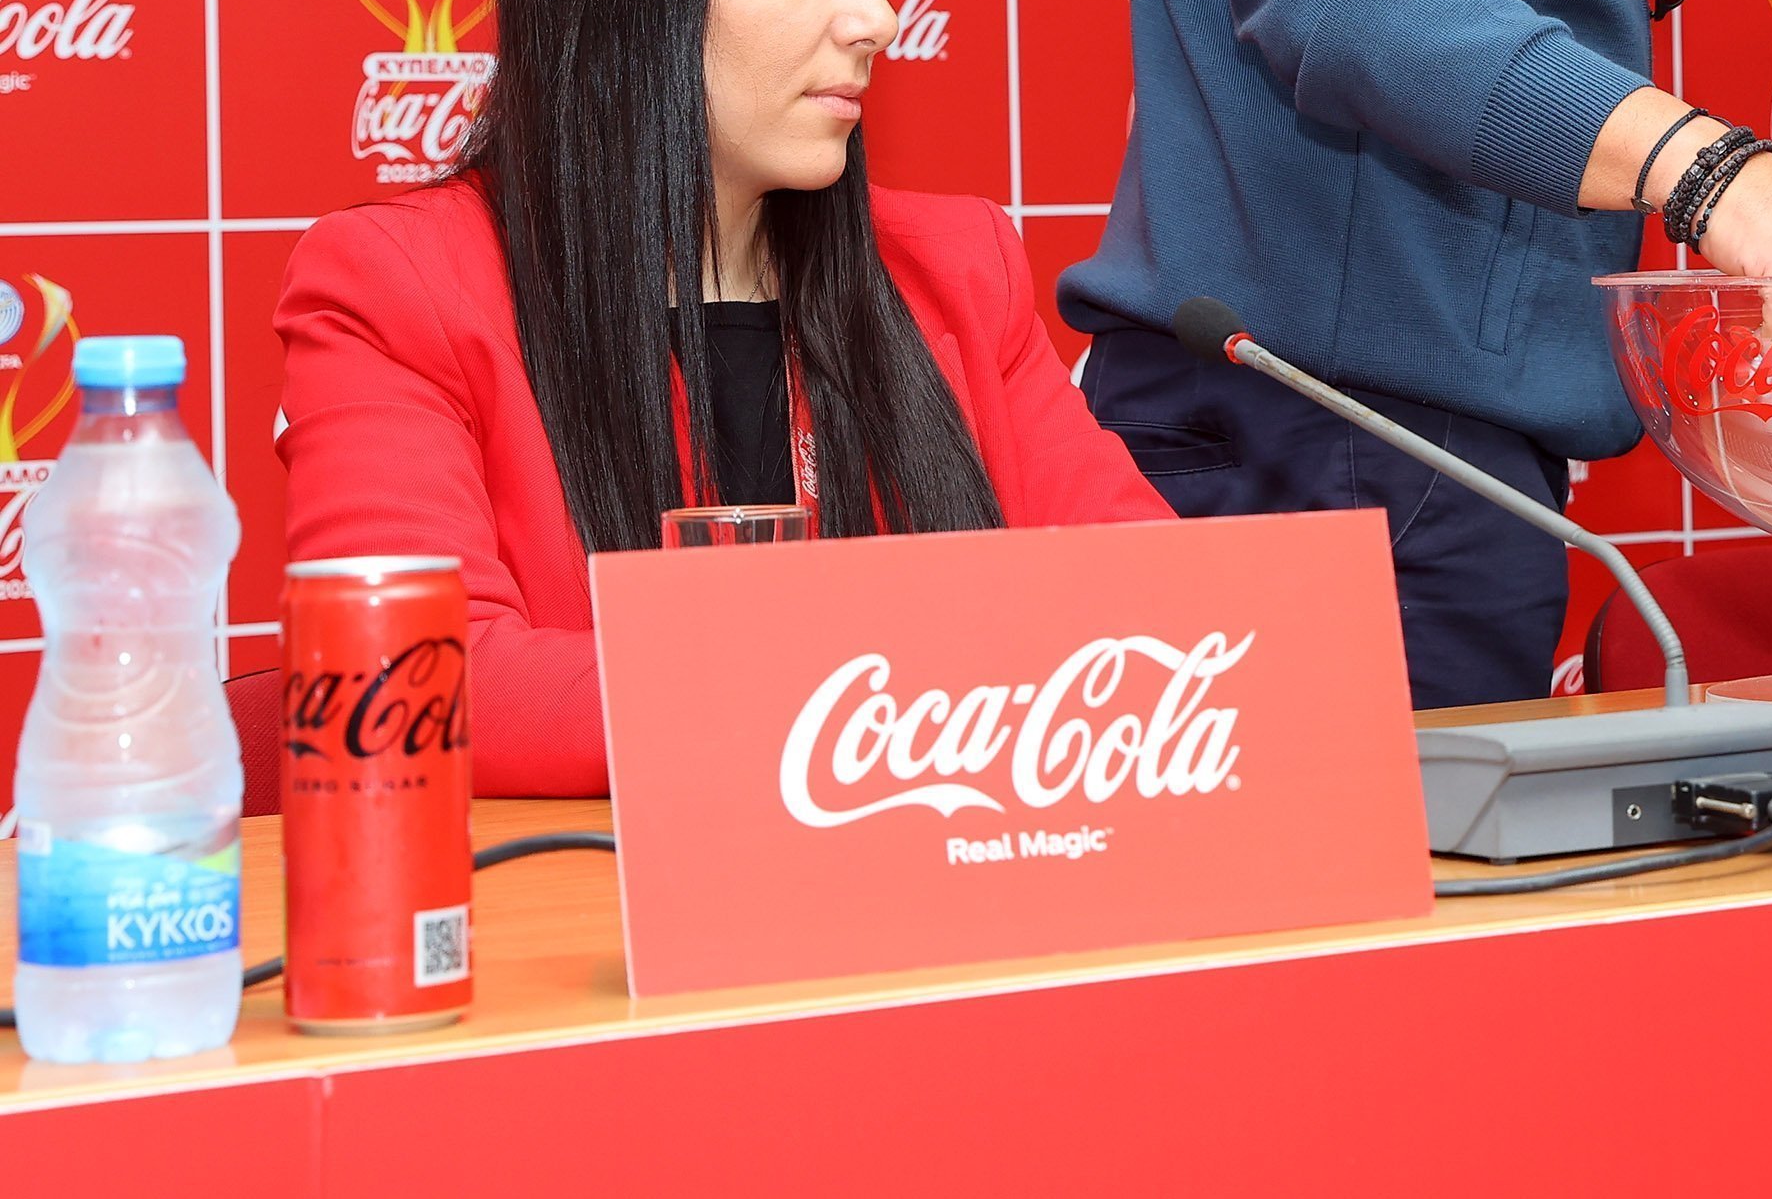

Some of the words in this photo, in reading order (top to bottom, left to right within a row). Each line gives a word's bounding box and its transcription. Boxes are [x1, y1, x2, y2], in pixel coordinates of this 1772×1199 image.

[376, 163, 460, 183] 2023-
[779, 630, 1256, 829] Coca-Cola
[947, 834, 1015, 865] Real
[1019, 826, 1108, 861] Magic
